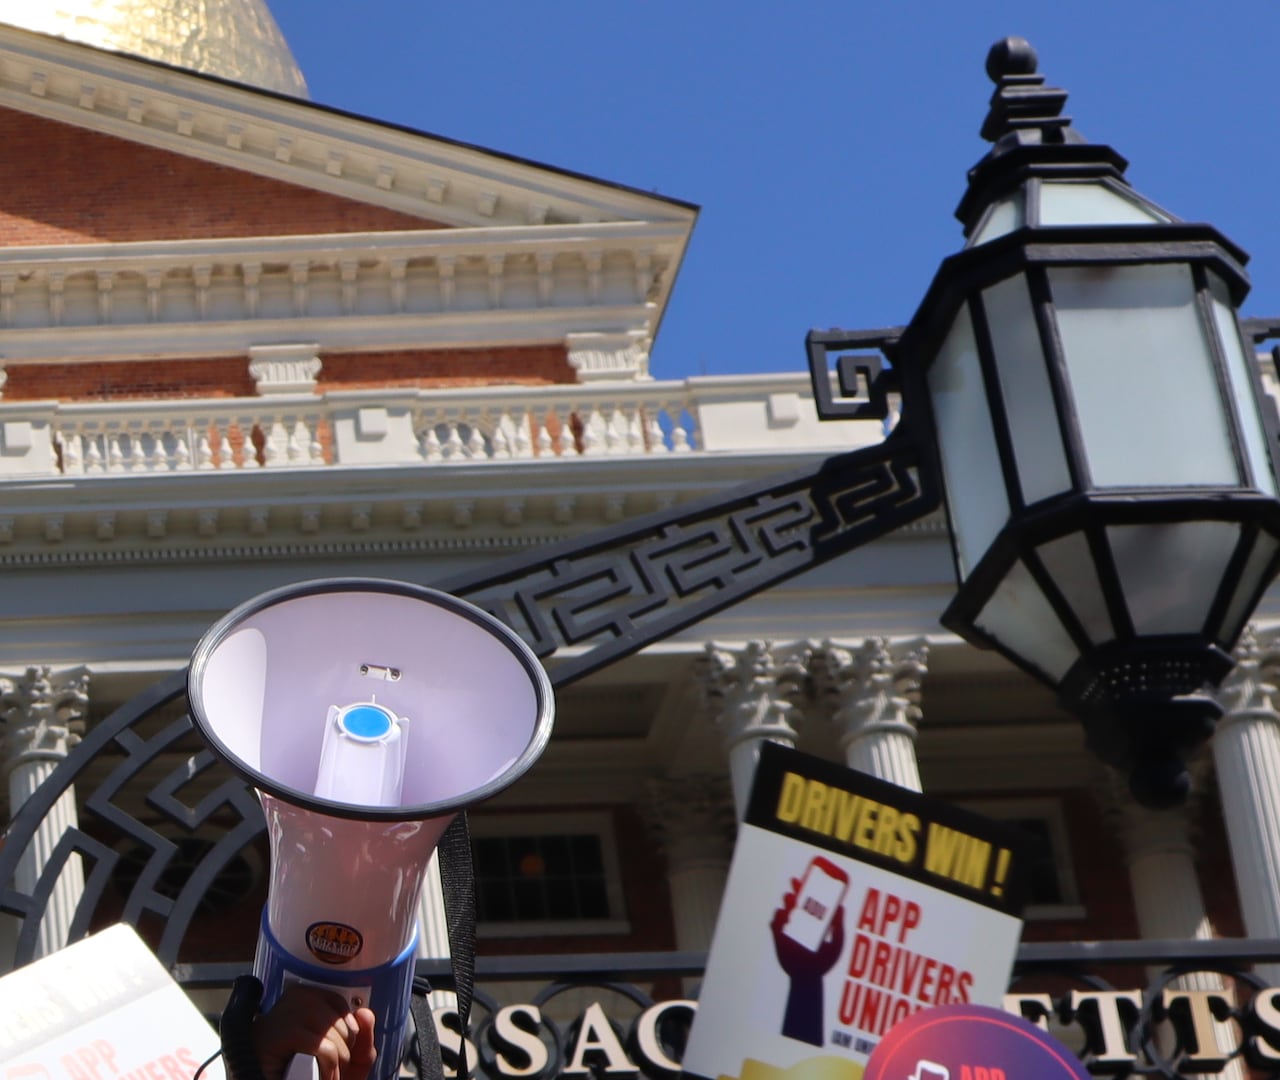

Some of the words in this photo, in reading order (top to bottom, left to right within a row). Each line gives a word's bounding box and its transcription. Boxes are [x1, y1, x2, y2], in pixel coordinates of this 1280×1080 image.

[777, 771, 922, 864] DRIVERS
[924, 822, 992, 891] WIN
[857, 887, 923, 945] APP
[848, 932, 976, 1005] DRIVERS
[838, 979, 924, 1037] UNIO
